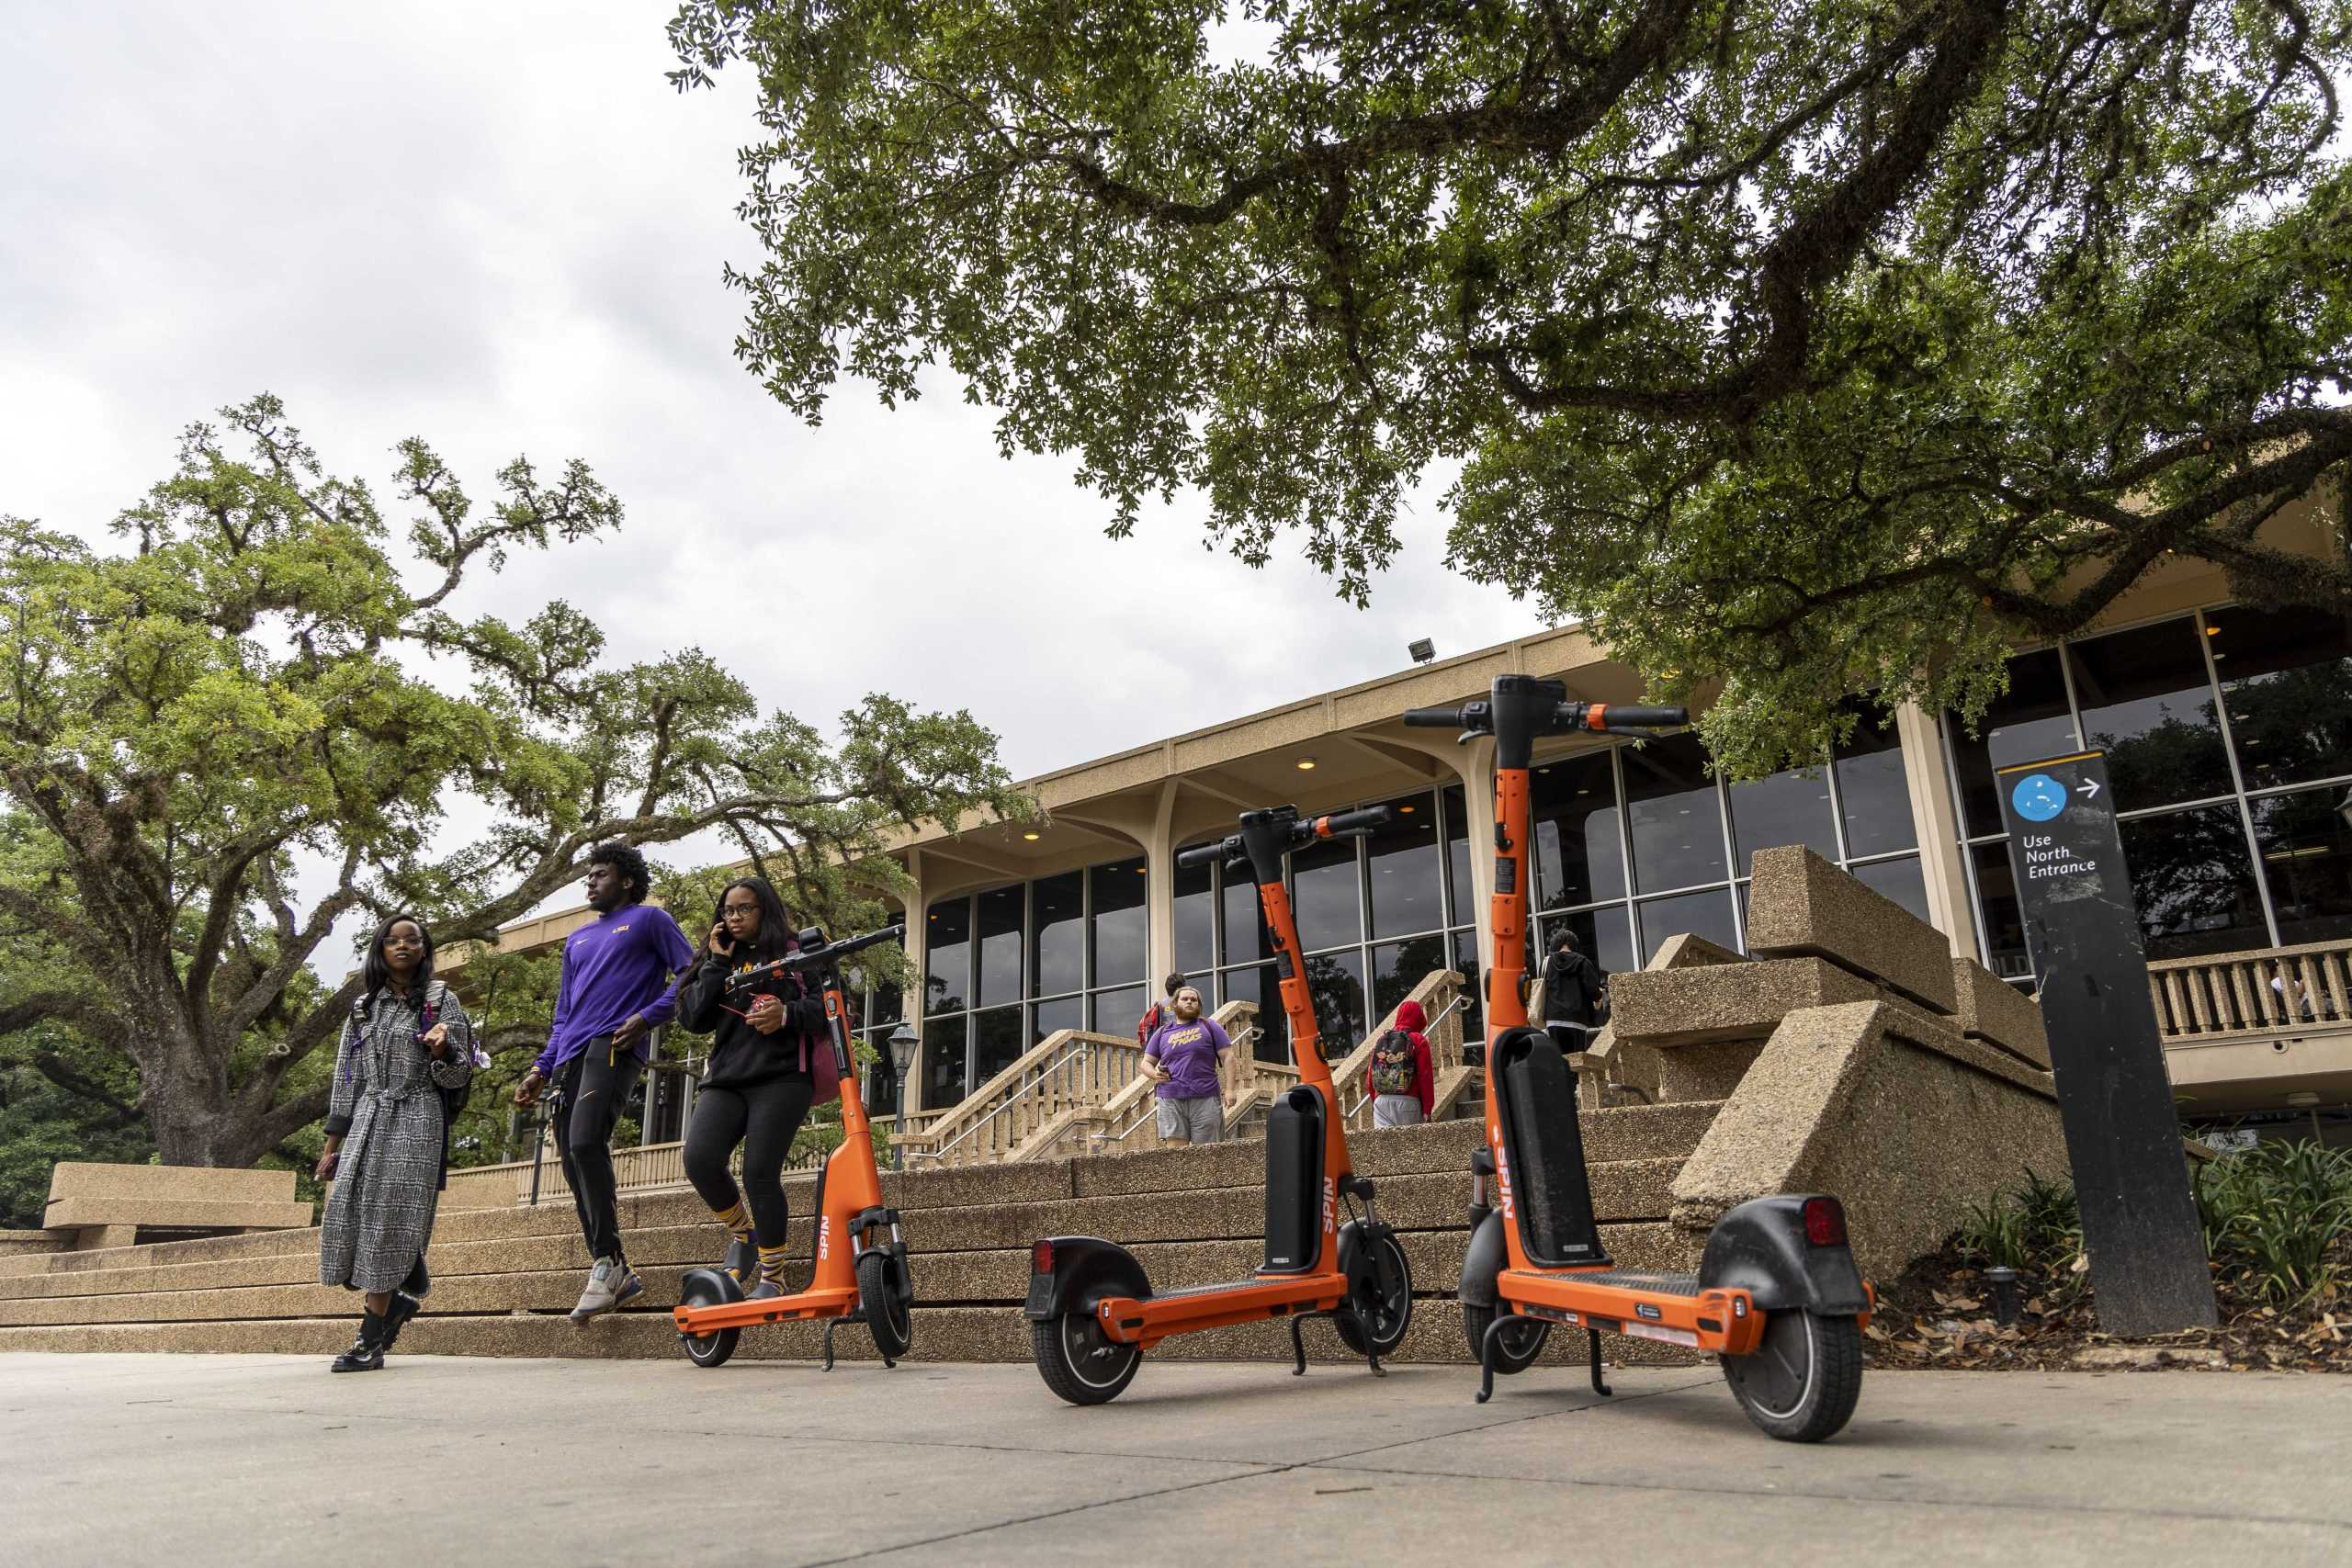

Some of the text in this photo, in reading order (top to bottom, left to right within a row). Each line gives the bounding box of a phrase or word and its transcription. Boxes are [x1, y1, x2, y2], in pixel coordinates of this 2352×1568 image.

[2023, 834, 2052, 849] Use
[2027, 846, 2070, 864] North
[2029, 861, 2096, 879] Entrance
[1498, 1146, 1514, 1219] SPIN
[1323, 1177, 1334, 1235] SPIN
[820, 1215, 830, 1260] SPIN
